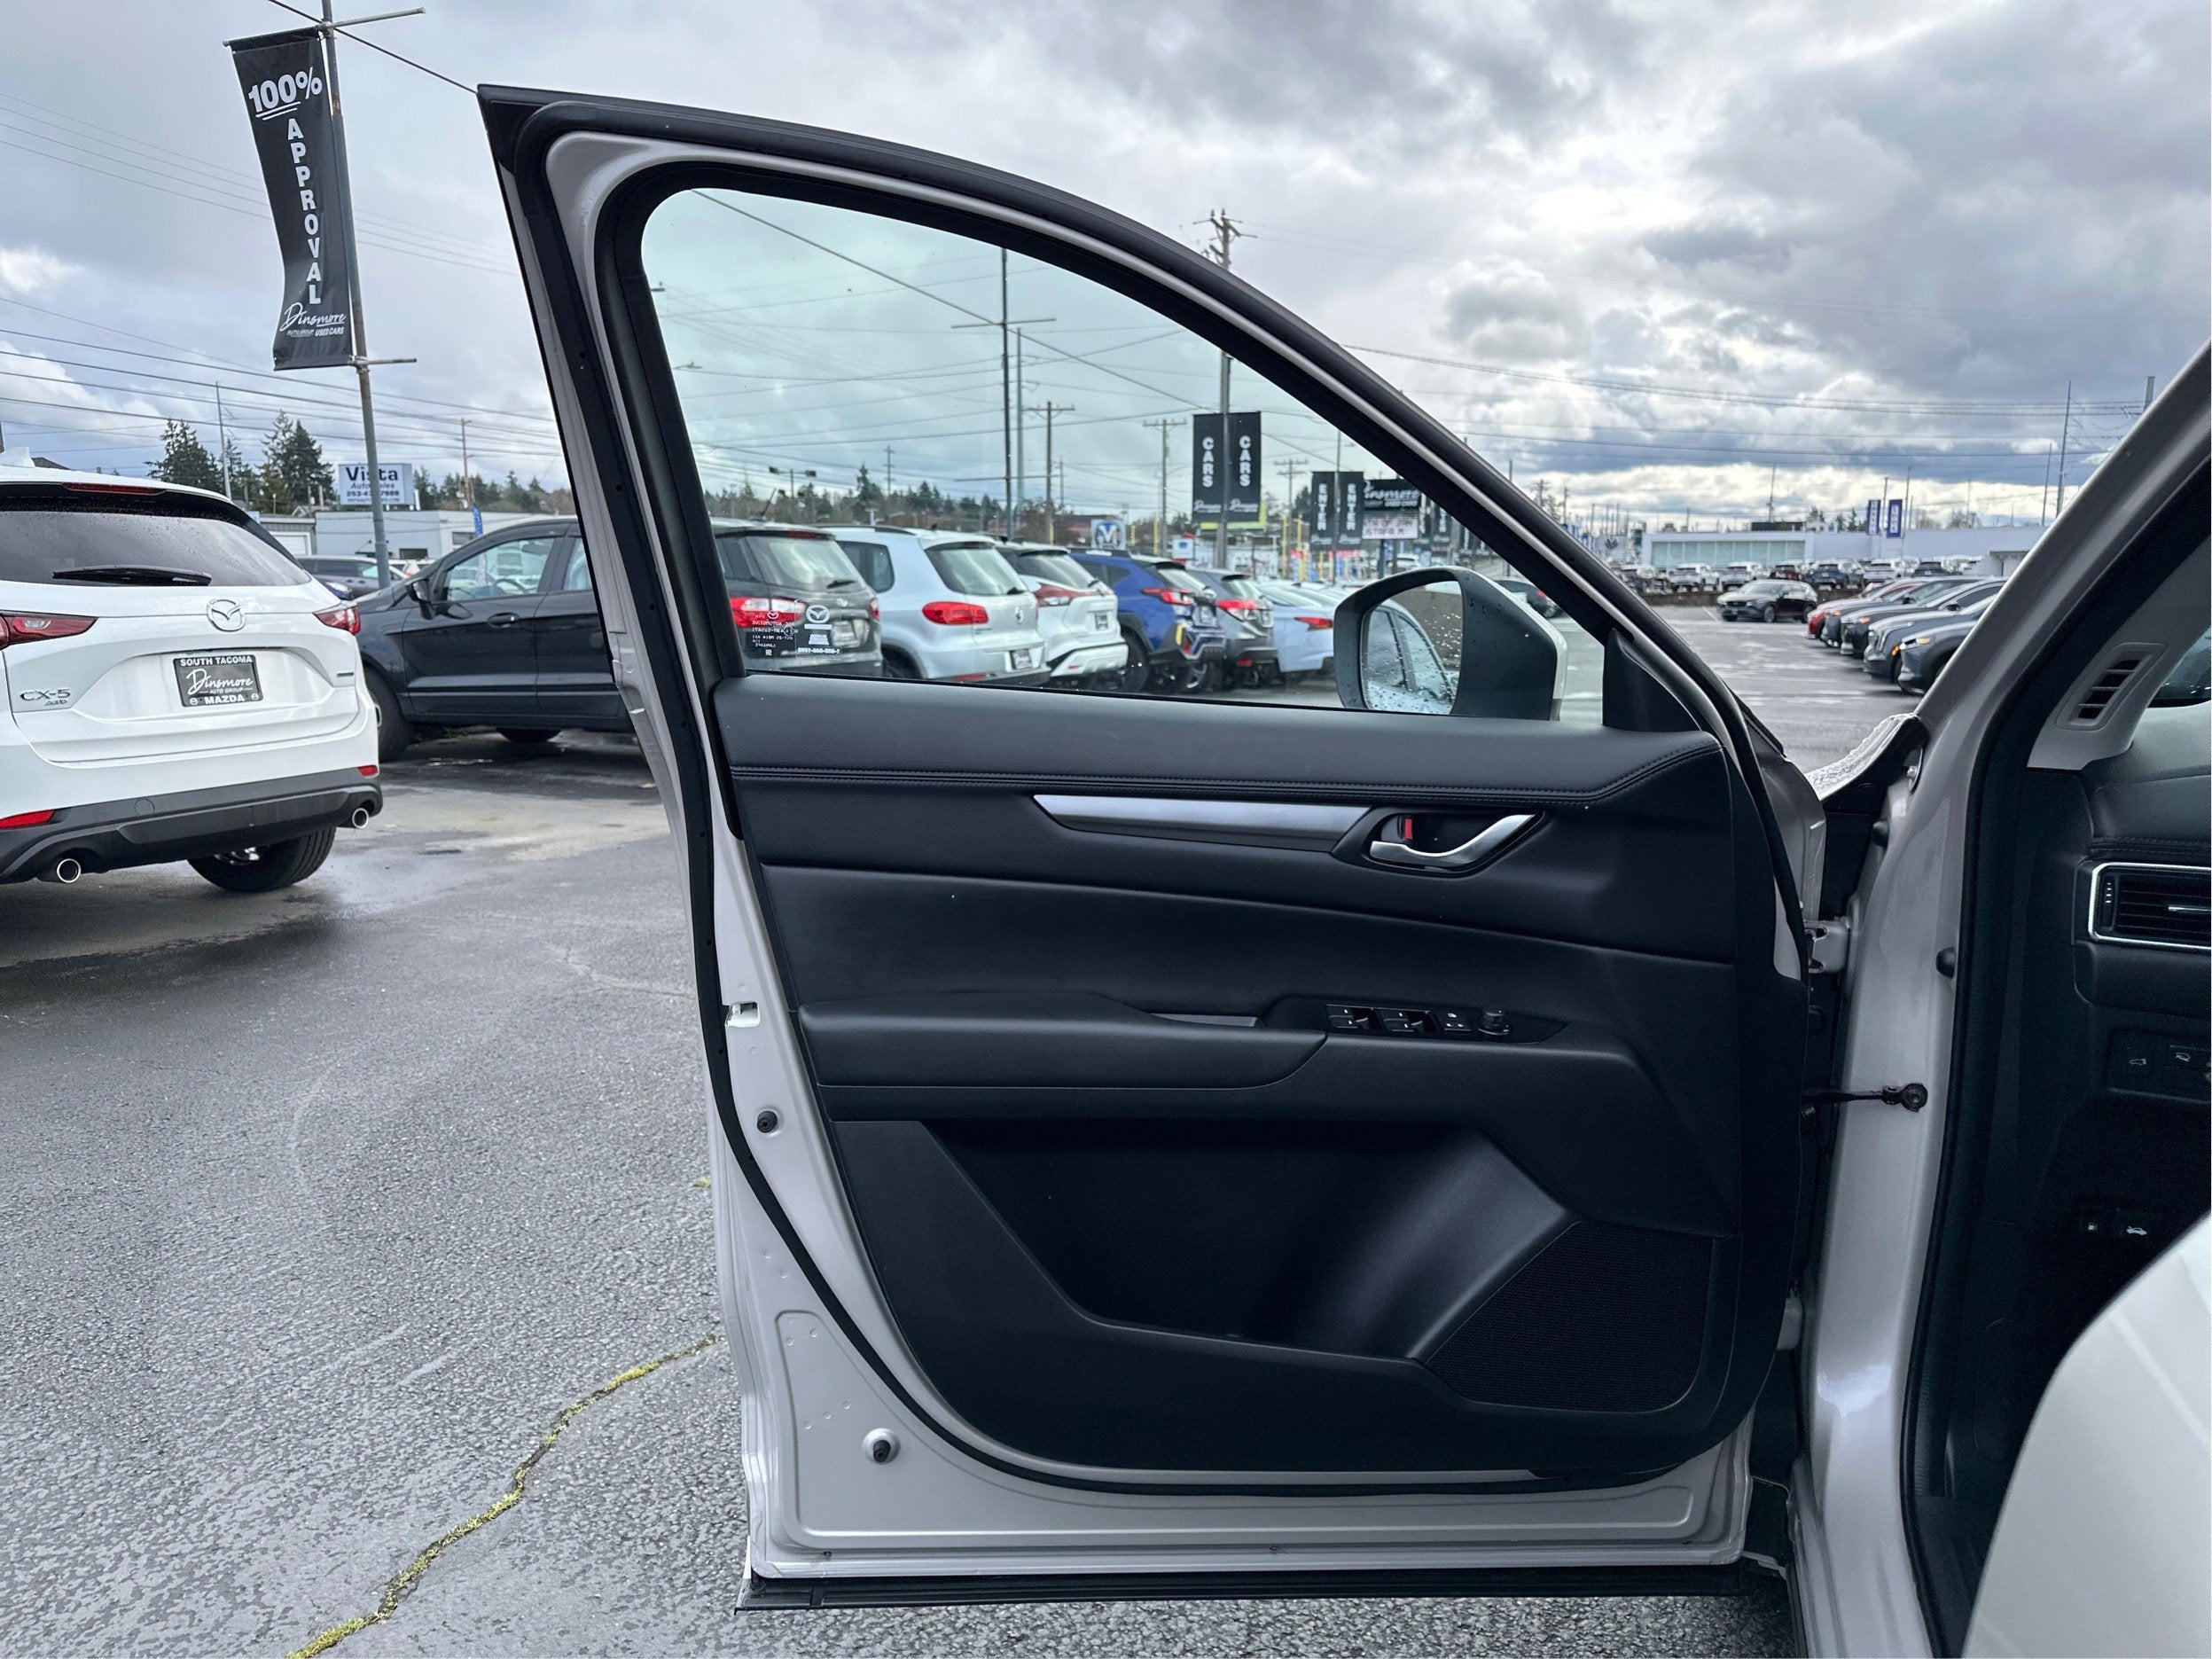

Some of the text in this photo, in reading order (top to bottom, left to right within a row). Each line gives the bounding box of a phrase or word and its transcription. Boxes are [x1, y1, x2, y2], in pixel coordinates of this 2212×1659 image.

[248, 67, 323, 113] 100%
[286, 118, 322, 305] APPROVAL
[279, 301, 347, 333] Dinsmore
[329, 326, 345, 335] CARS
[345, 466, 399, 481] Vita
[1202, 436, 1215, 488] CARS
[1239, 434, 1252, 487] CARS
[1346, 482, 1357, 530] ENTER
[180, 655, 253, 667] SOUTH TACOMA
[20, 687, 71, 701] CX-5
[185, 668, 254, 695] Dinsmore
[204, 693, 246, 705] MAZDA
